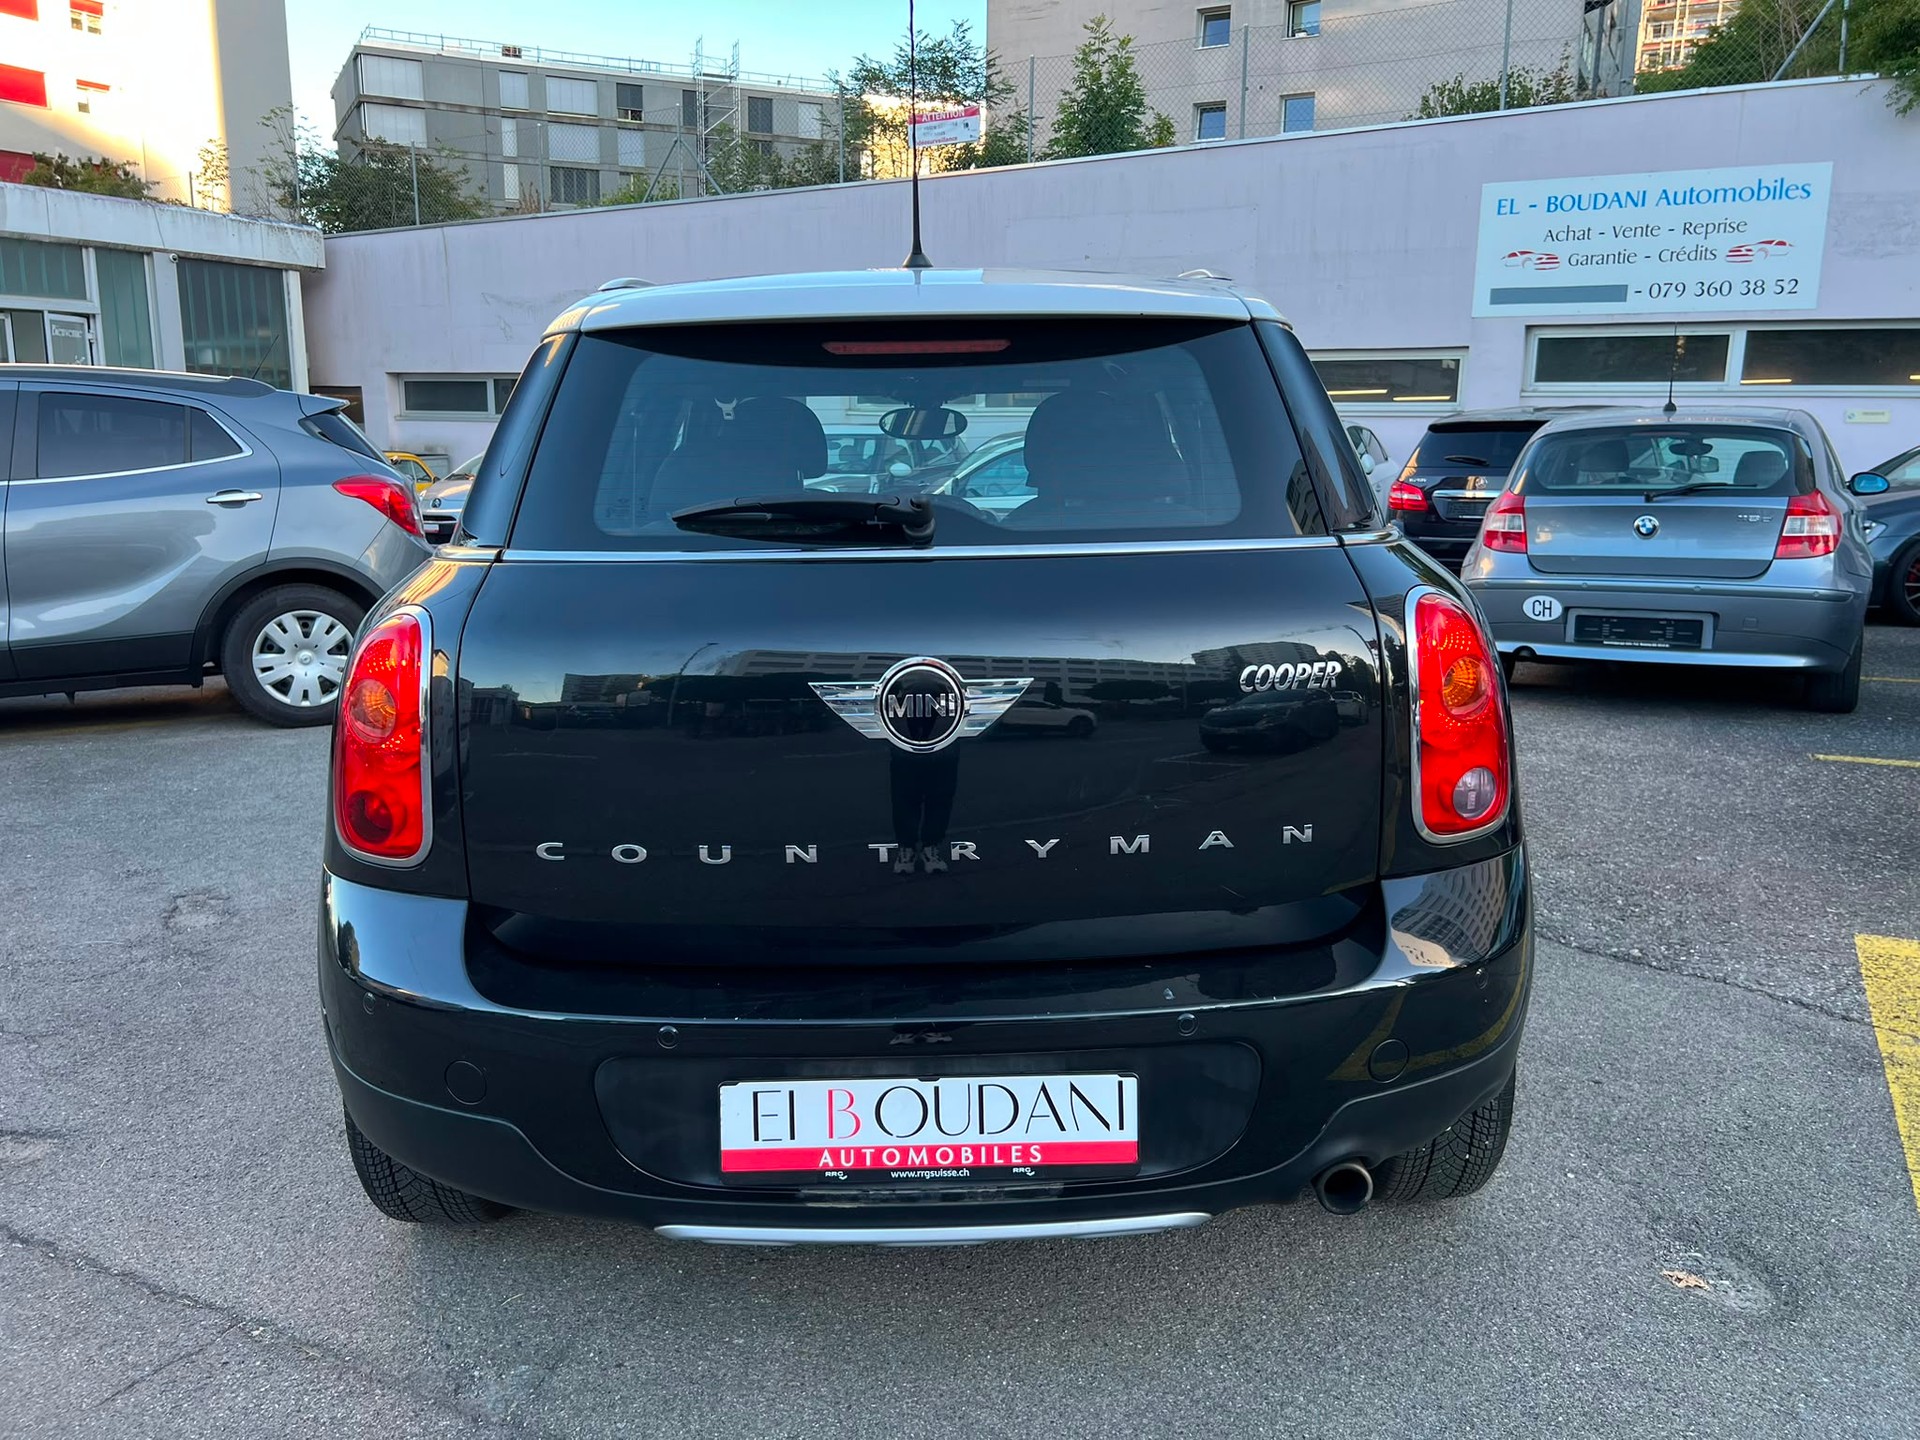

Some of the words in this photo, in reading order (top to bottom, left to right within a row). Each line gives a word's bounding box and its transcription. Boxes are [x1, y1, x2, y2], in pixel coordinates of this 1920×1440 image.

[922, 109, 965, 122] ATTENTION
[1497, 198, 1520, 215] EL
[1546, 191, 1647, 213] BOUDANI
[1656, 178, 1812, 207] Automobiles
[1544, 225, 1592, 242] Achat
[1612, 222, 1660, 238] Vente
[1682, 218, 1748, 238] Reprise
[1568, 249, 1637, 268] Garantie
[1658, 246, 1717, 263] Crédits
[1649, 282, 1686, 299] 079
[1694, 280, 1732, 297] 360
[1740, 279, 1765, 296] 38
[1773, 278, 1799, 295] 52
[1532, 599, 1552, 618] CH
[1239, 661, 1343, 693] COOPER
[888, 693, 956, 718] MINI
[535, 823, 1314, 865] COUNTRYMAN
[827, 1080, 1125, 1140] BOUDANI
[818, 1144, 1043, 1168] AUTOMOBILES
[890, 1168, 970, 1180] www.rrgsuisse.ch
